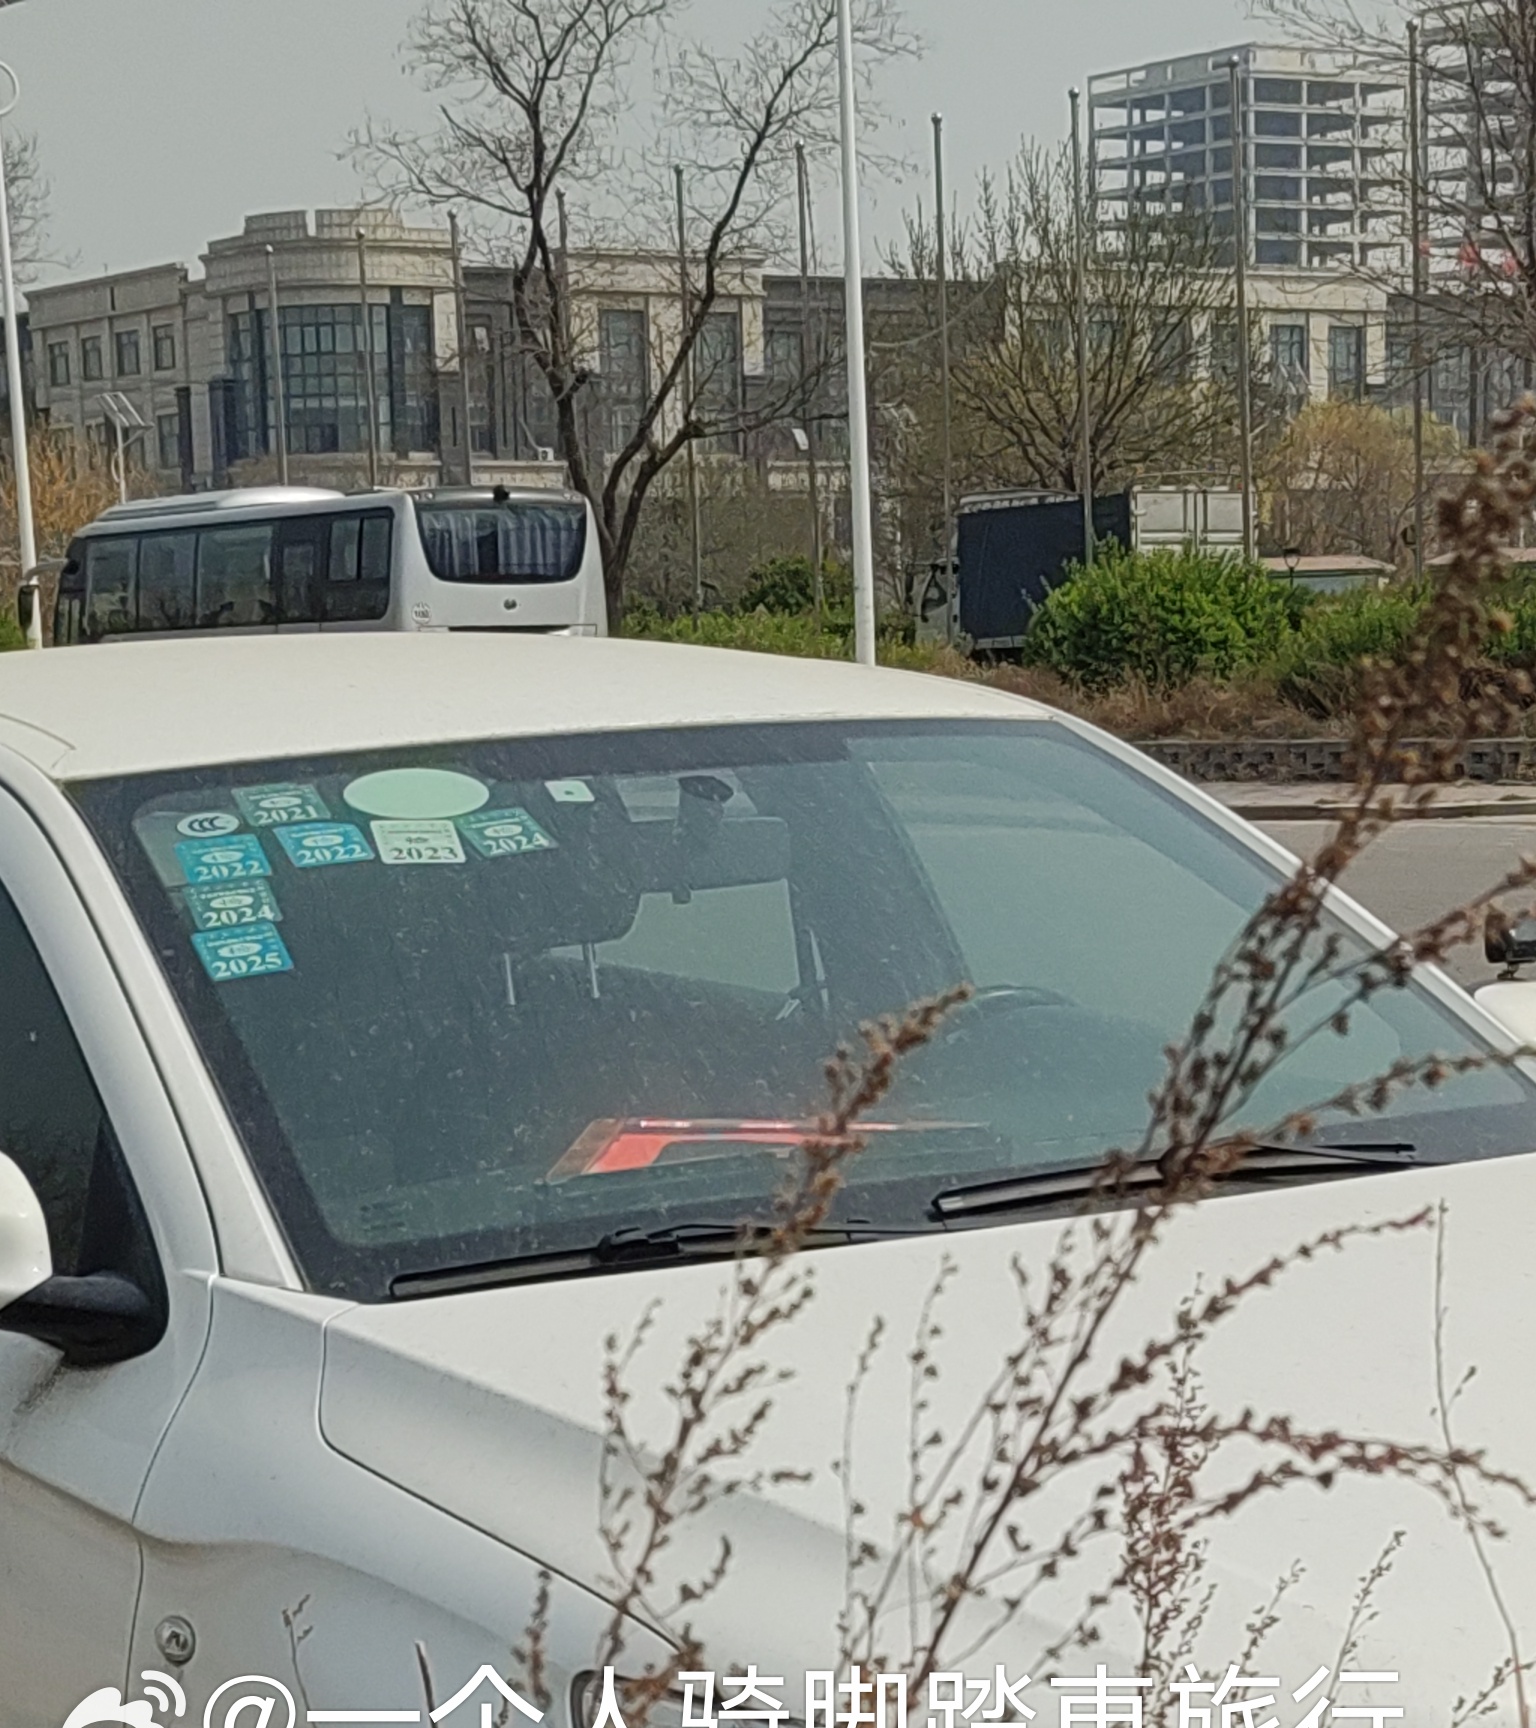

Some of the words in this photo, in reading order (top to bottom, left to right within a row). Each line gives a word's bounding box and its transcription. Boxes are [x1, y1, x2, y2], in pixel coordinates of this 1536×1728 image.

[254, 805, 318, 825] 2021
[297, 844, 368, 865] 2022
[389, 847, 458, 861] 2023
[483, 832, 550, 856] 2024
[194, 861, 264, 882] 2022
[202, 905, 275, 928] 2024
[211, 952, 282, 978] 2025
